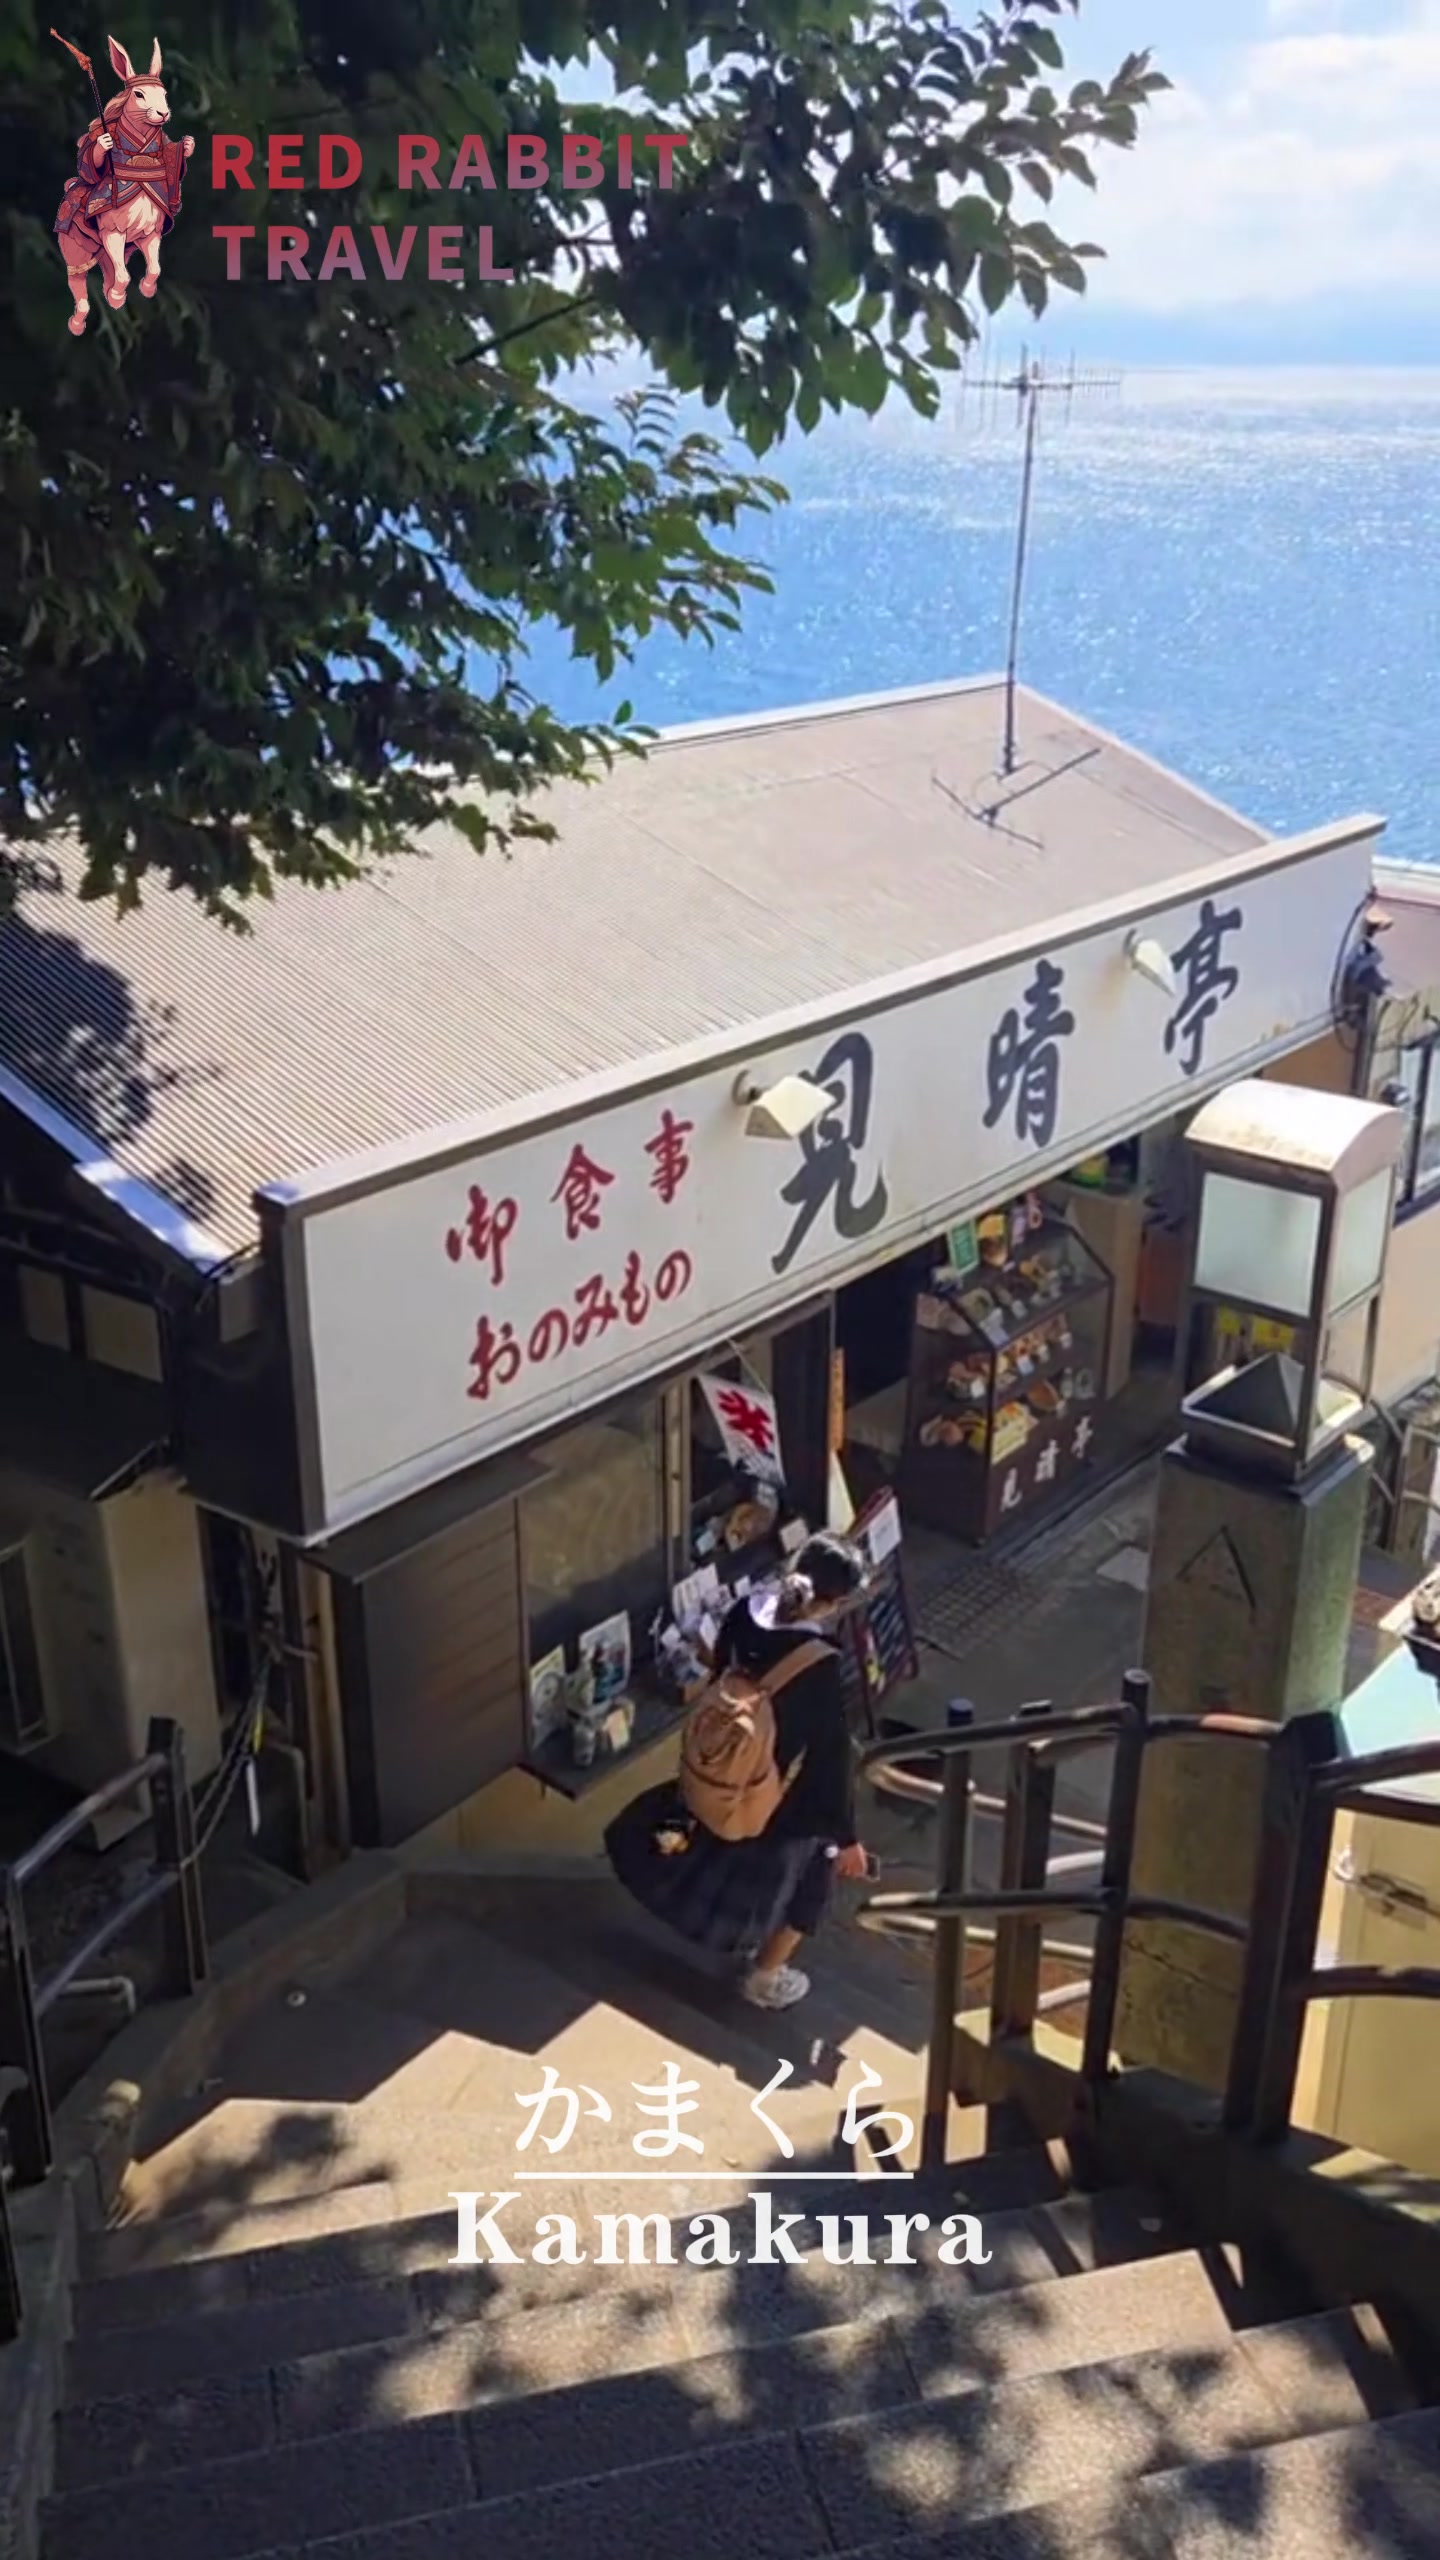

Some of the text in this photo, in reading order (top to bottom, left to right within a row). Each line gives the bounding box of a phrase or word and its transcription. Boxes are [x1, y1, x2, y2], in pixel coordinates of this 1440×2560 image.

[771, 900, 1243, 1275] 見晴亭
[446, 1109, 694, 1287] 御食事
[466, 1249, 693, 1400] おのみもの
